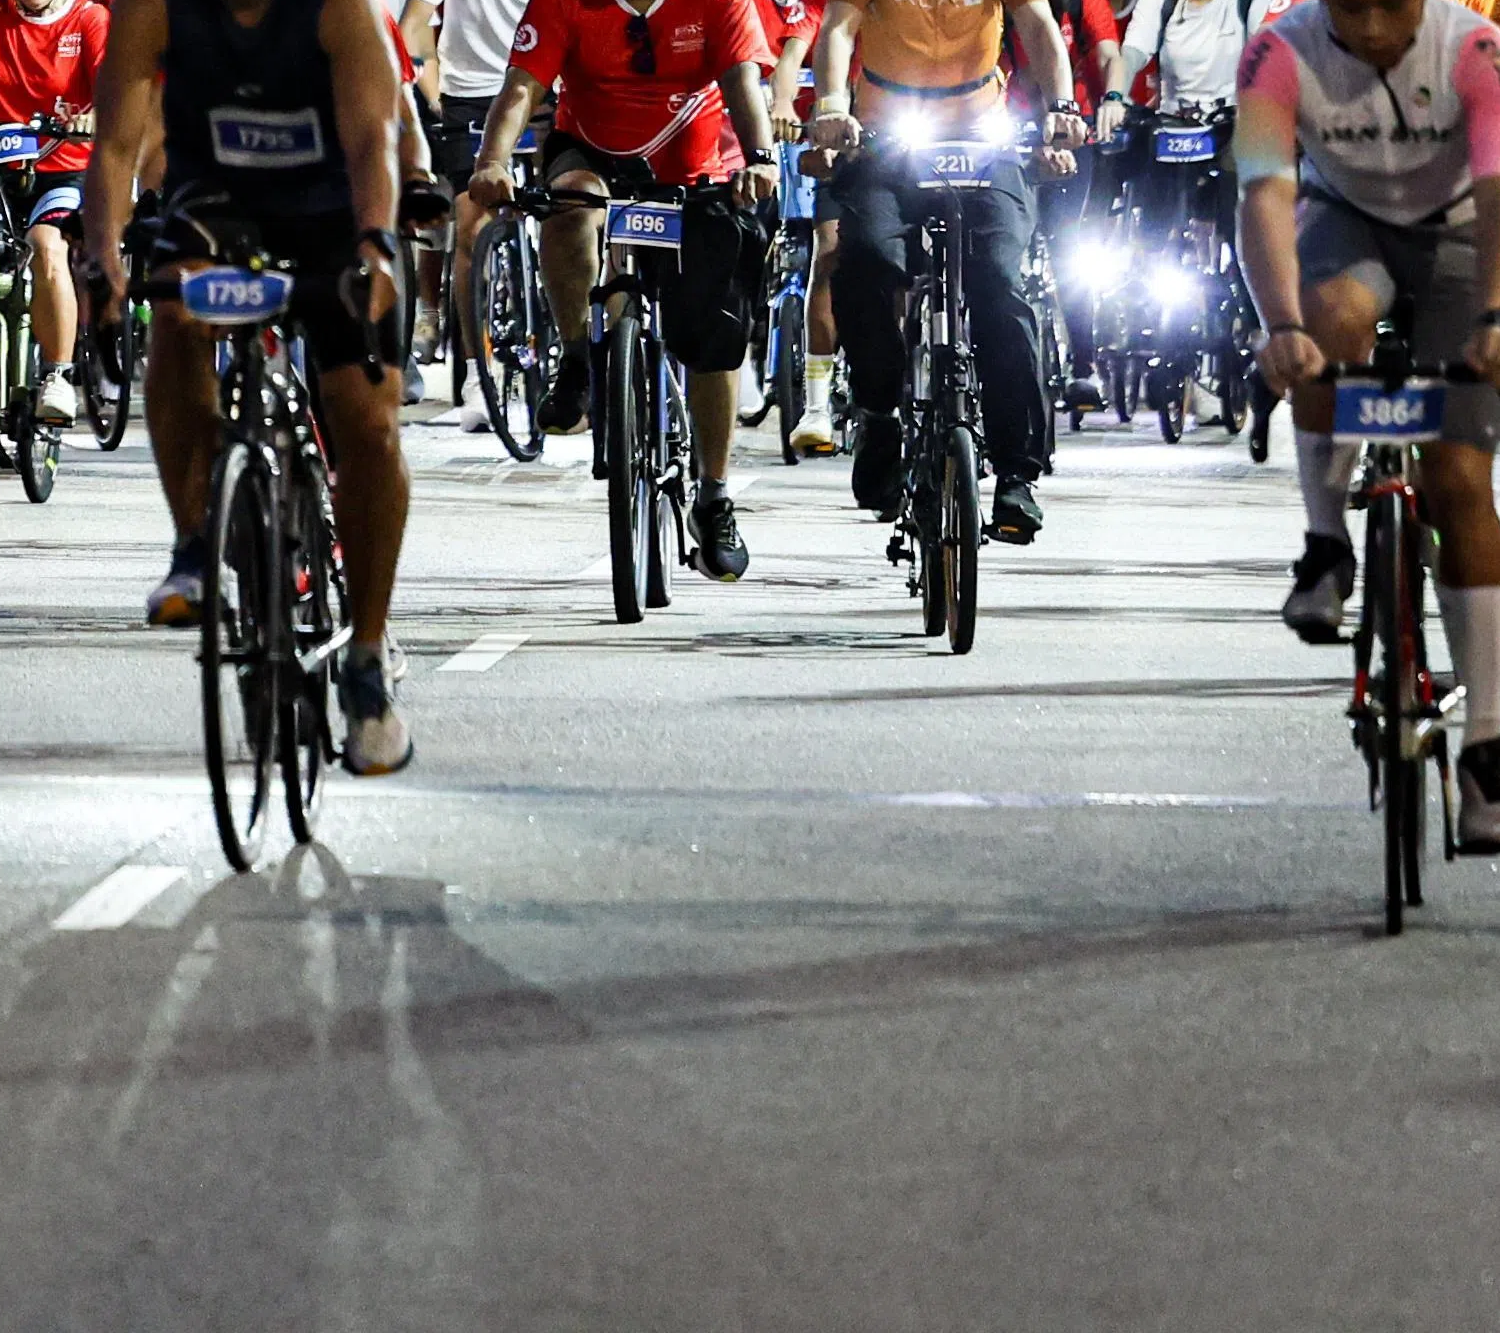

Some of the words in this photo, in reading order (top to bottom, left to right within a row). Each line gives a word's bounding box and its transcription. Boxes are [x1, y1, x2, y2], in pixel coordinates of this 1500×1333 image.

[934, 155, 975, 174] 2211
[624, 213, 666, 234] 1696
[206, 280, 266, 307] 1795
